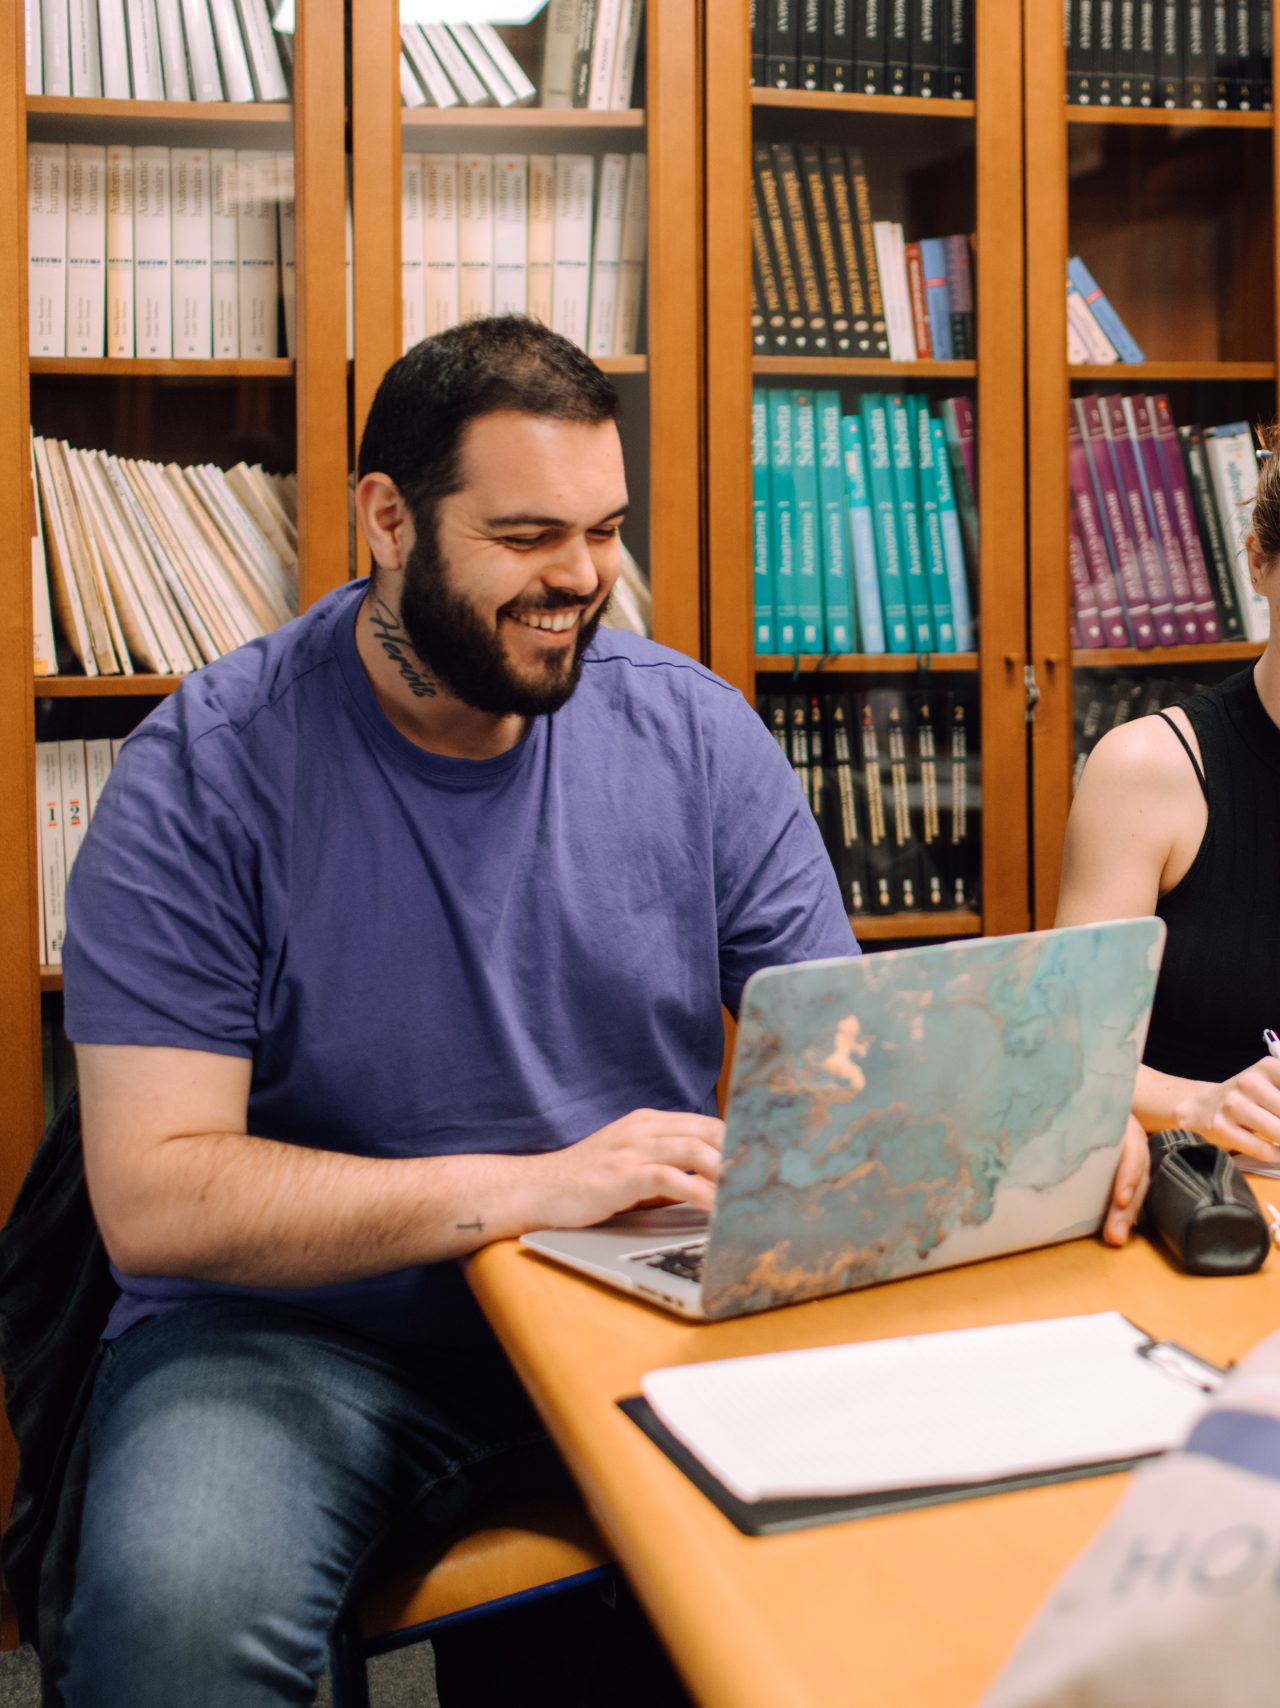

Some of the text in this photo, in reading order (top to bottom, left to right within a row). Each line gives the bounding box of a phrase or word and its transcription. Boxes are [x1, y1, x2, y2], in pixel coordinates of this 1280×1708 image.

[775, 405, 792, 466] Sobotta
[796, 406, 815, 467] Sobotta
[823, 406, 841, 467] Sobotta
[870, 408, 890, 468] Sobotta
[894, 409, 913, 468] Sobotta
[755, 511, 768, 575] Anatomie
[778, 511, 793, 576] Anatomie
[800, 512, 815, 576] Anatomie
[828, 513, 843, 576] Anatomie
[884, 513, 900, 575] Anatomie
[908, 513, 923, 574] Anatomie
[928, 513, 945, 574] Anatomie
[49, 808, 55, 821] 1
[70, 806, 80, 820] 2
